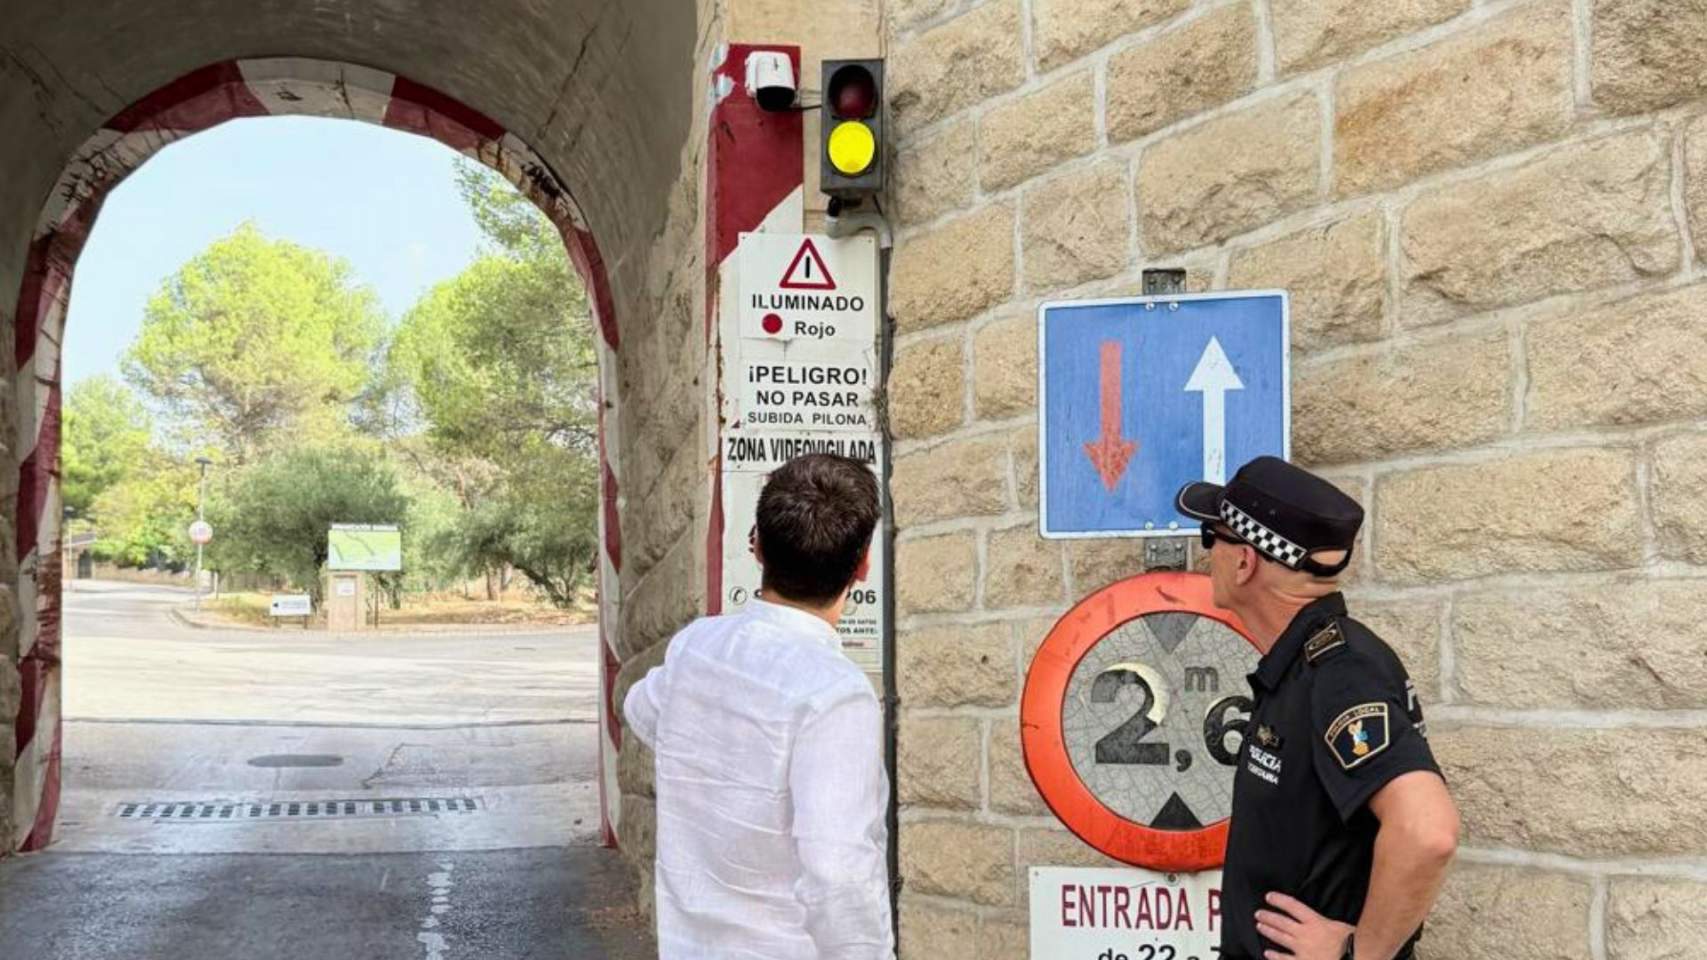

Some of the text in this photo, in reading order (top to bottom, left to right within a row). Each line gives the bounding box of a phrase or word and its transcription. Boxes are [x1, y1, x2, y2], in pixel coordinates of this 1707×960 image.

[752, 293, 864, 312] ILUMINADO
[794, 321, 836, 339] Rojo
[749, 366, 867, 385] ¡PELIGRO!
[756, 390, 859, 407] NO PASAR
[748, 412, 867, 425] SUBIDA PILONA
[727, 437, 767, 462] ZONA
[1061, 884, 1194, 931] ENTRADA
